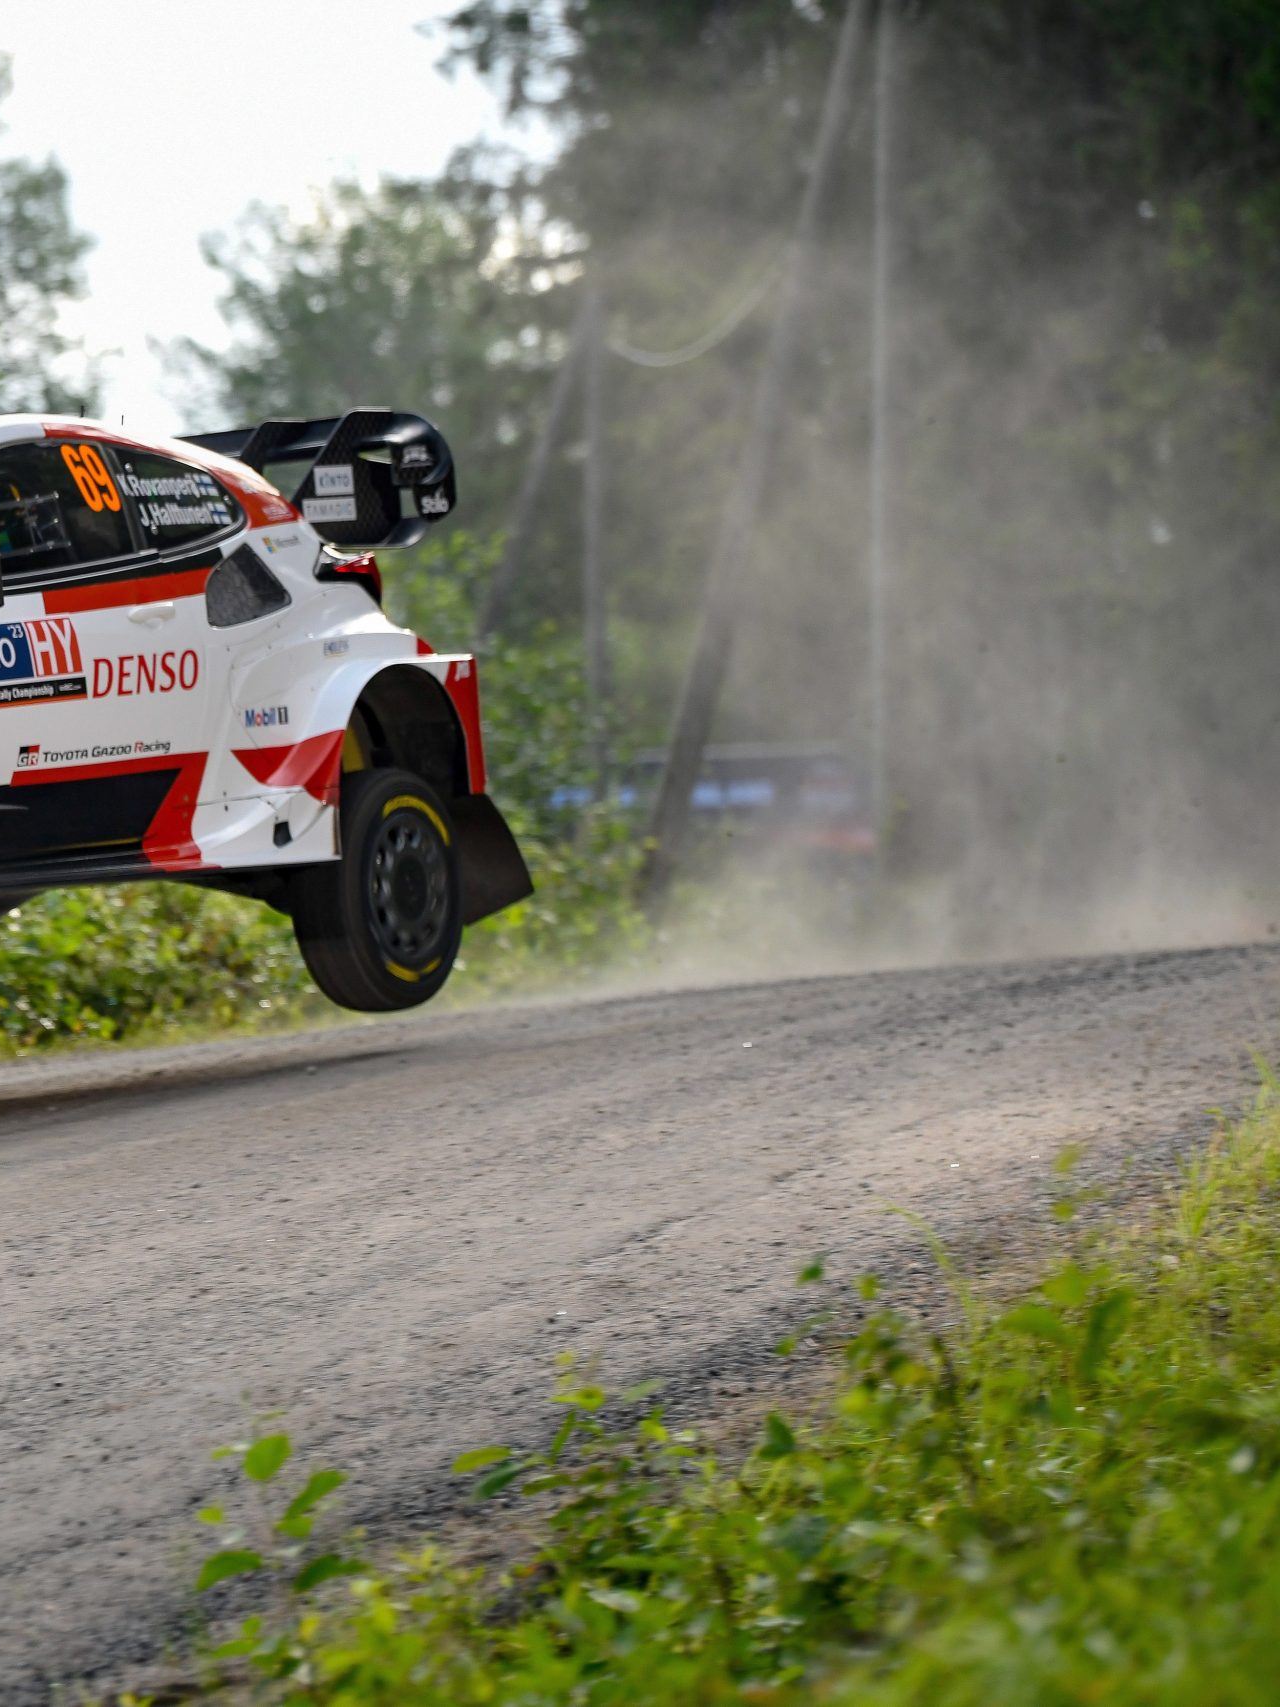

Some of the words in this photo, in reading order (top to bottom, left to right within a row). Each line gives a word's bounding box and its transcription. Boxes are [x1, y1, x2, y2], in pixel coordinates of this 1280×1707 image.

[60, 444, 121, 512] 69
[93, 650, 199, 698] DENSO
[245, 707, 276, 728] Mobil
[19, 753, 38, 766] GR
[43, 750, 88, 763] TOYOTA
[91, 745, 131, 758] GAZOO
[134, 740, 171, 754] Racing
